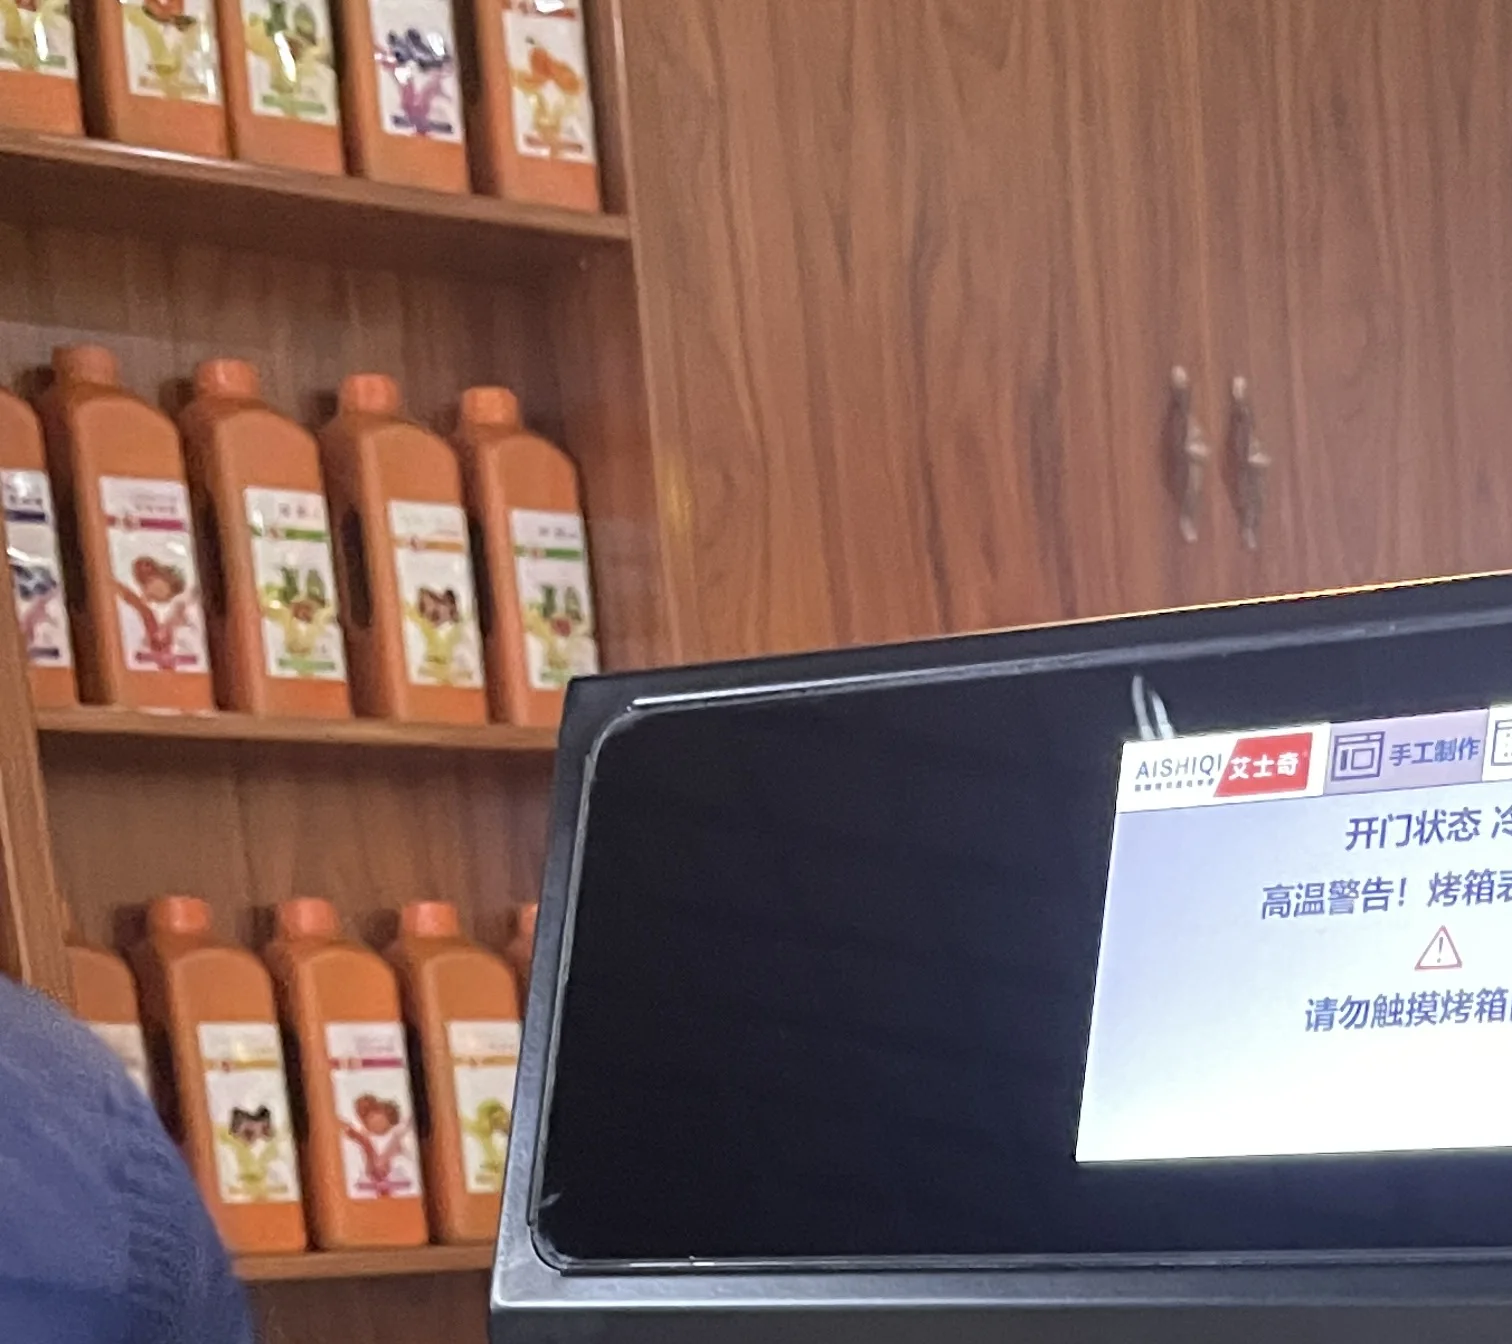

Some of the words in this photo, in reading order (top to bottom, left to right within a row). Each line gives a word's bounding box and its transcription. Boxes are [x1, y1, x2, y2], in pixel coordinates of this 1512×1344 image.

[1389, 737, 1480, 766] 手工制作
[1136, 754, 1222, 780] AISHIQI
[1228, 752, 1299, 780] 艾士奇
[1345, 806, 1482, 851] 开门状态
